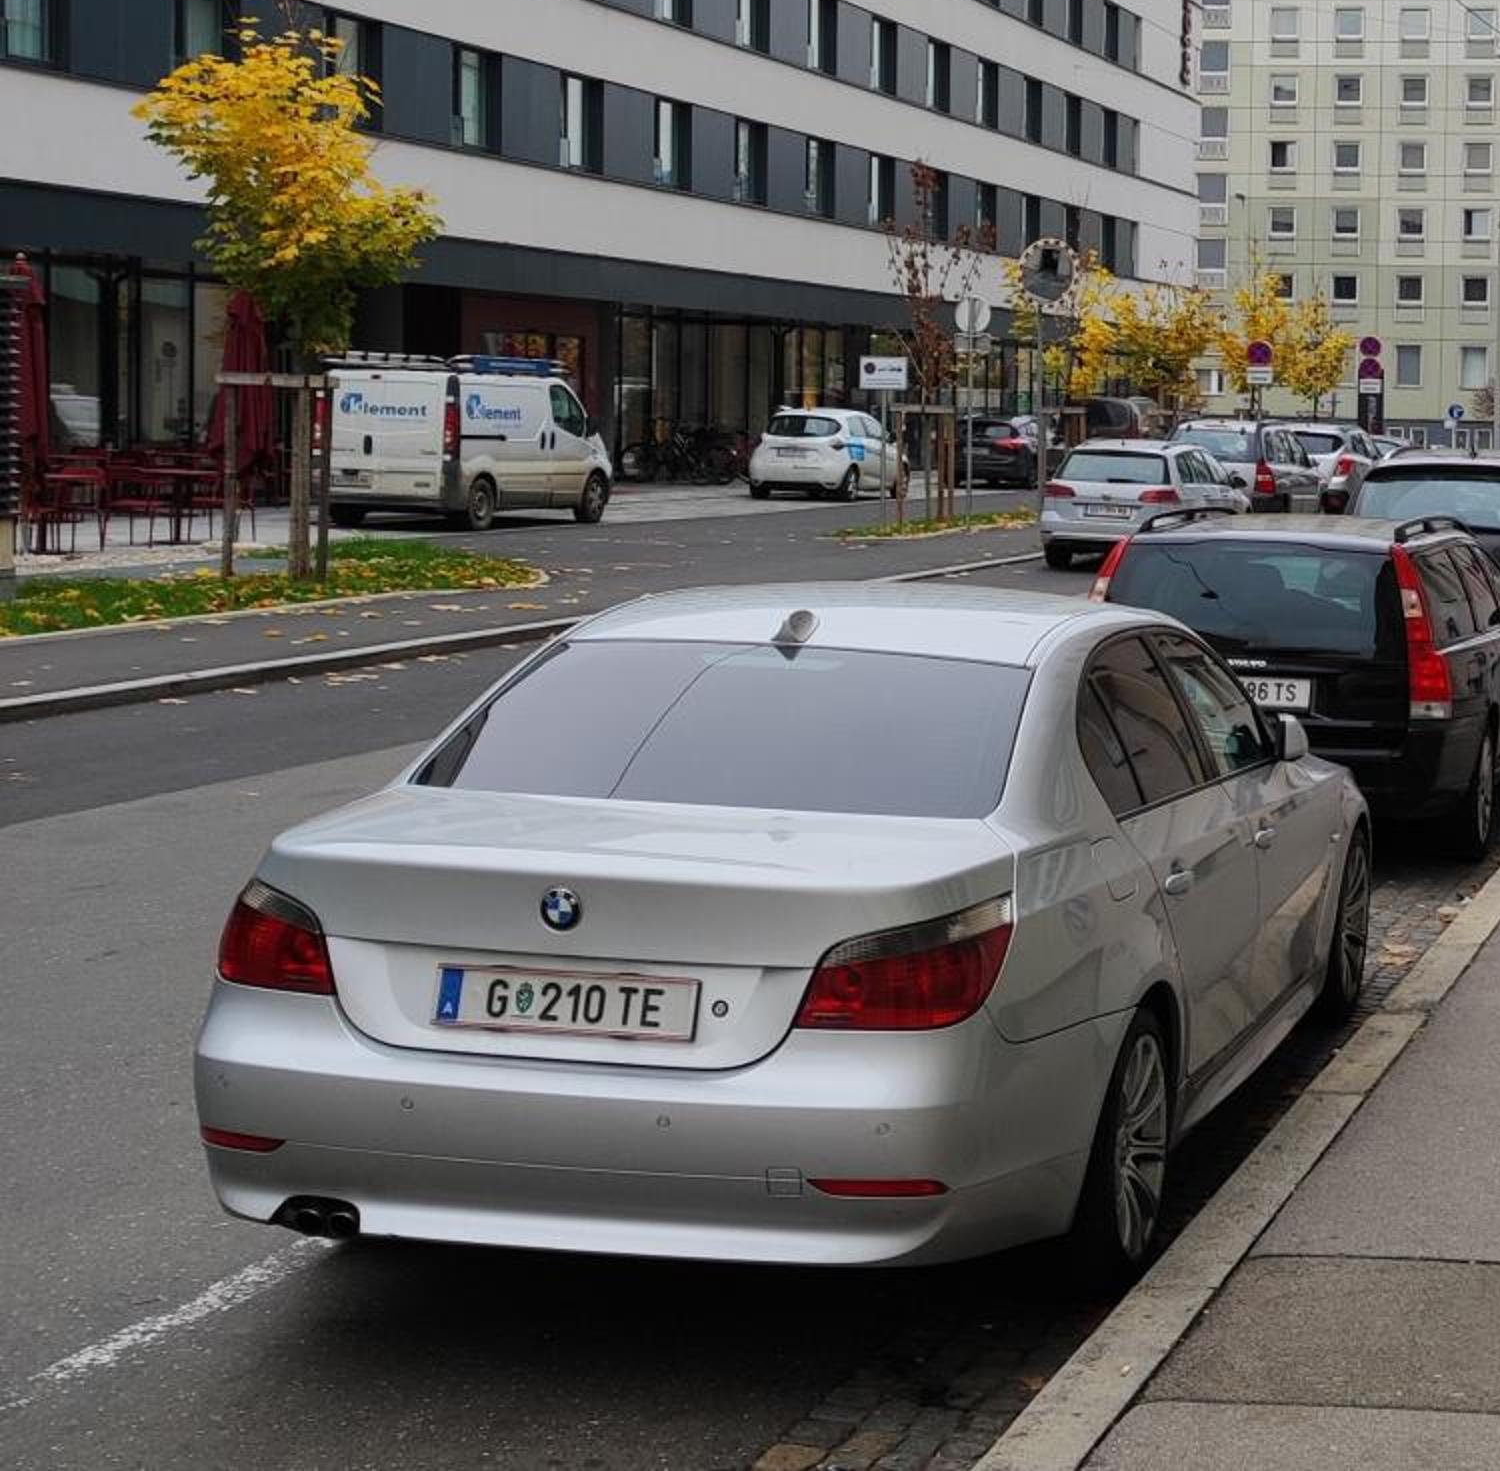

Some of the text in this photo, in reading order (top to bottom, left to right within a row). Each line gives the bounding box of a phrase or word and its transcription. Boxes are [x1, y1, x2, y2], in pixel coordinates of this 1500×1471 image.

[1274, 682, 1297, 702] TS
[441, 1001, 454, 1015] A
[486, 978, 665, 1027] G 210 TE
